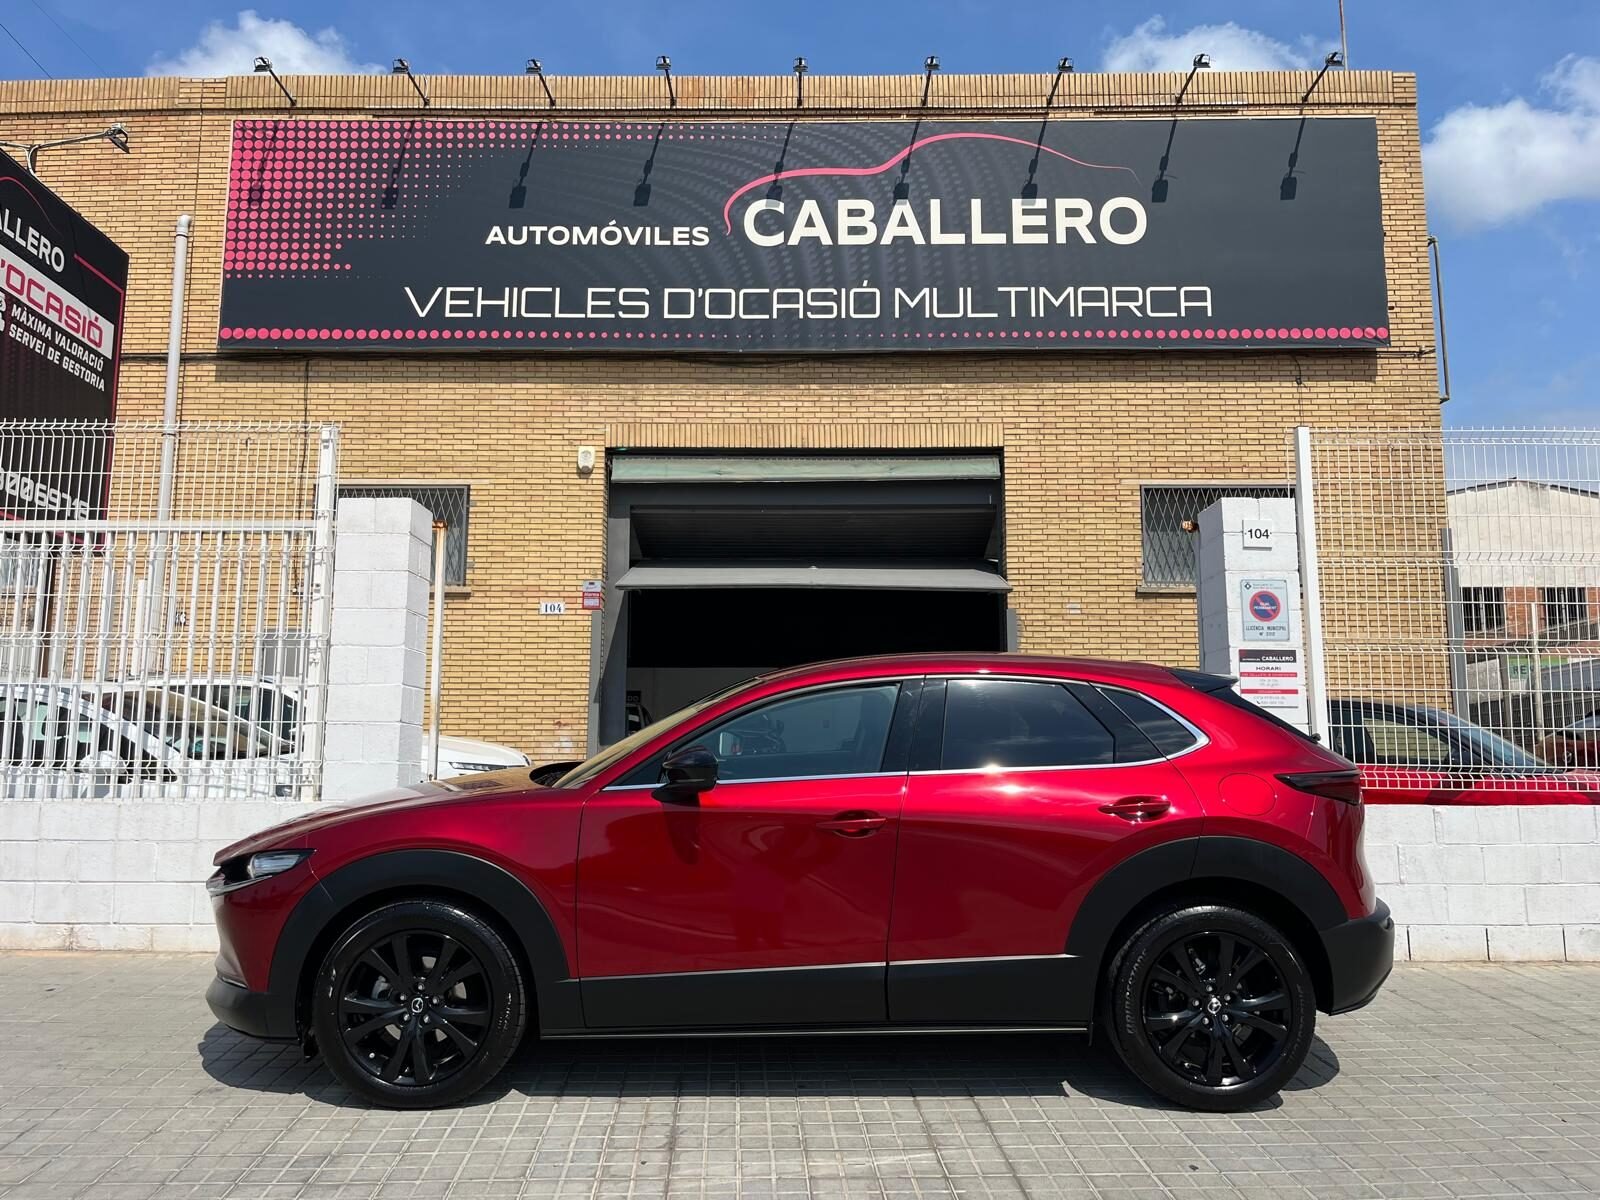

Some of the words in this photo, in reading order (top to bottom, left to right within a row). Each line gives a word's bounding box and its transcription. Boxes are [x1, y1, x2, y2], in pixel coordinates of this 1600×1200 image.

[0, 208, 65, 273] LLERO
[485, 219, 709, 246] AUTOMÓVILES
[743, 196, 1148, 247] CABALLERO
[404, 286, 650, 319] VEHICLES
[663, 280, 881, 320] D'OCASIÓ
[8, 323, 46, 356] SERVEI
[47, 346, 61, 365] DE
[62, 356, 105, 392] GESTORIA
[11, 303, 52, 341] MÀXIMA
[55, 330, 104, 372] VALORACIÓ
[1247, 528, 1269, 539] 104
[545, 603, 561, 613] 104
